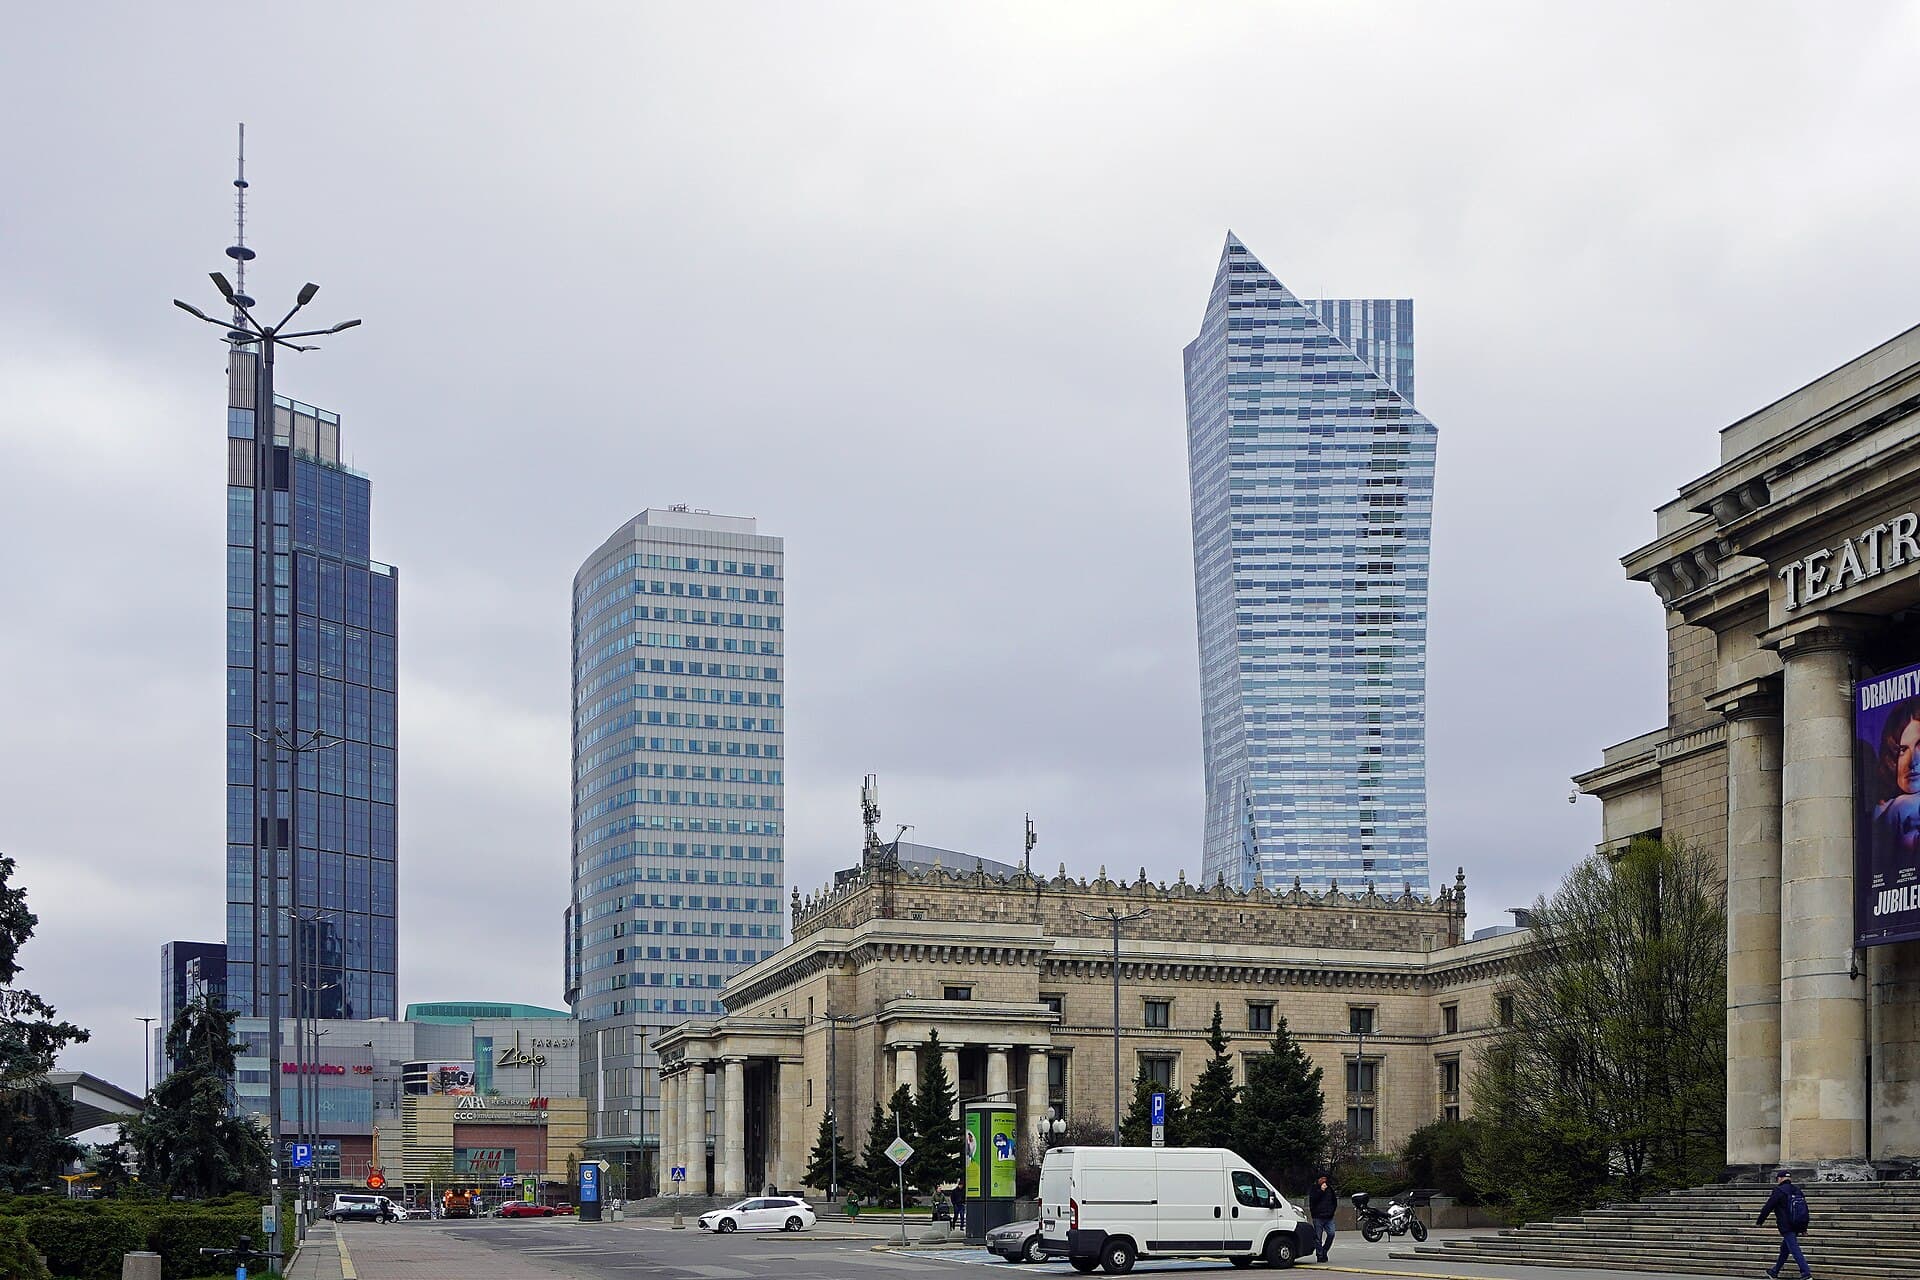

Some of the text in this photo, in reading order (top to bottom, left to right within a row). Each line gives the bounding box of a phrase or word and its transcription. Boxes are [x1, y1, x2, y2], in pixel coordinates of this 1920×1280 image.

[1778, 512, 1920, 611] TEATR
[531, 1038, 574, 1049] TARASY
[457, 1096, 487, 1109] ZARA
[1154, 1096, 1163, 1117] P
[453, 1111, 473, 1120] CCC
[296, 1145, 308, 1161] P
